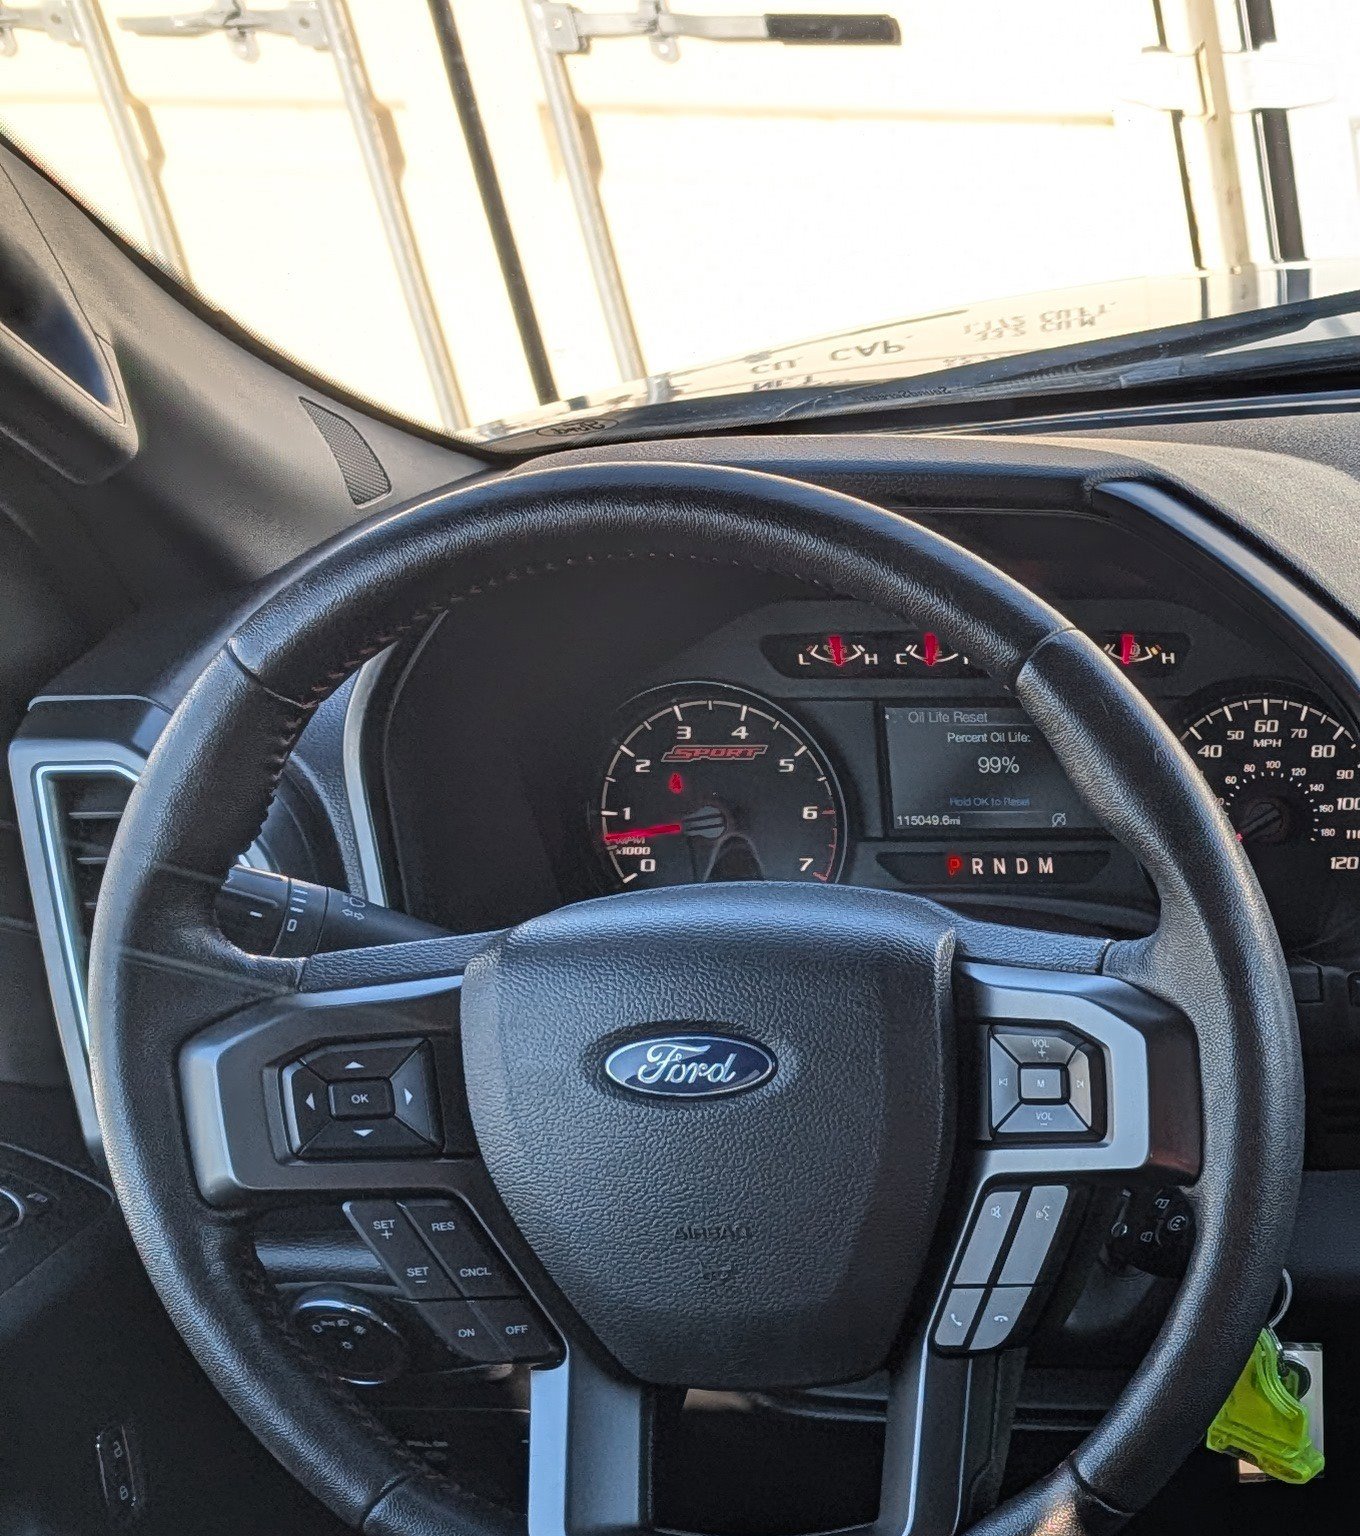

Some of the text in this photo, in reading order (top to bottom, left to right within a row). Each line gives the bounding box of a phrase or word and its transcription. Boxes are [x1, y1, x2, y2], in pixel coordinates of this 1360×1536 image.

[865, 653, 879, 666] H
[1162, 652, 1176, 664] H
[908, 712, 925, 724] Oil
[953, 711, 989, 723] Reset
[1254, 719, 1280, 733] 60
[676, 726, 692, 740] 3
[731, 726, 749, 740] 4
[947, 731, 1031, 743] Percent Oil Life:
[1226, 730, 1245, 741] 50
[1290, 728, 1308, 739] 70
[1253, 739, 1282, 748] MPH
[665, 746, 766, 761] SPORT
[1197, 744, 1223, 758] 40
[1310, 744, 1336, 758] 80
[635, 759, 651, 773] 2
[778, 758, 795, 773] 5
[977, 756, 1020, 773] 99%
[1243, 764, 1256, 773] 80
[1265, 761, 1281, 769] 100
[1291, 768, 1307, 777] 120
[1336, 769, 1354, 780] 90
[1225, 776, 1237, 785] 60
[1309, 784, 1325, 792] 140
[622, 807, 631, 820] 1
[803, 807, 818, 820] 6
[1318, 805, 1334, 813] 160
[1321, 829, 1336, 837] 180
[615, 846, 651, 855] x1000
[640, 858, 656, 872] 0
[799, 858, 814, 872] 7
[971, 857, 984, 875] R
[993, 857, 1007, 875] N
[1016, 857, 1029, 875] D
[1038, 857, 1054, 874] M
[1330, 856, 1360, 870] 120
[638, 1044, 736, 1084] Ford
[351, 1094, 369, 1104] OK
[373, 1220, 395, 1230] SET
[432, 1222, 455, 1231] RES
[407, 1267, 429, 1277] SET
[460, 1267, 492, 1278] CNCL
[458, 1328, 475, 1338] ON
[505, 1325, 528, 1335] OFF
